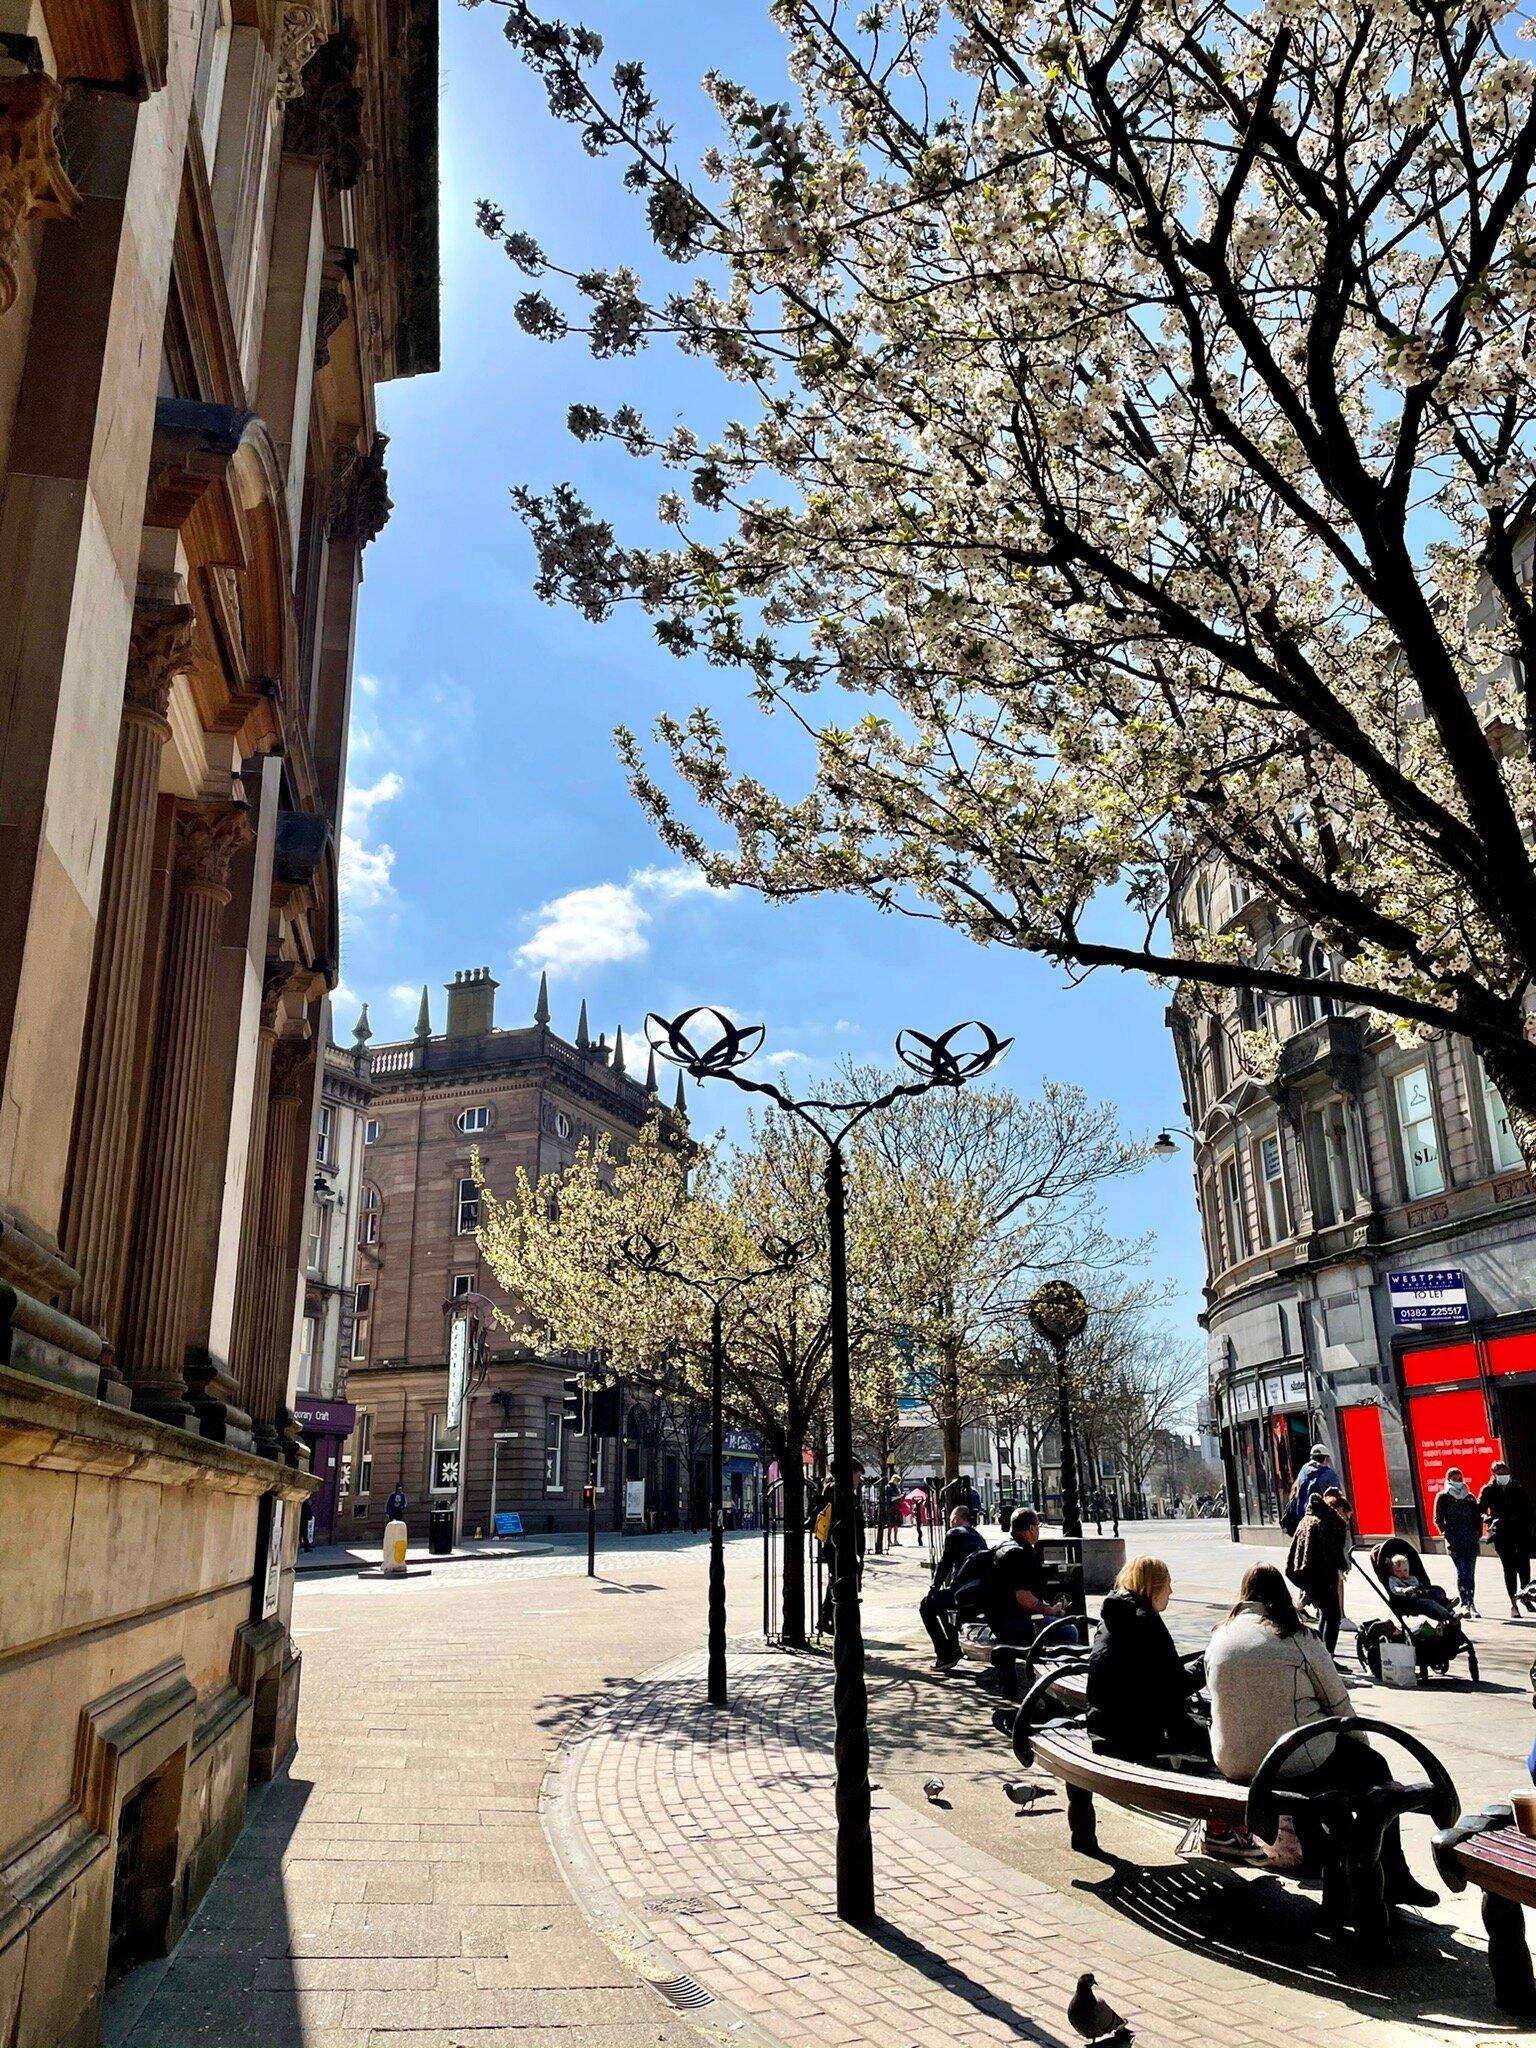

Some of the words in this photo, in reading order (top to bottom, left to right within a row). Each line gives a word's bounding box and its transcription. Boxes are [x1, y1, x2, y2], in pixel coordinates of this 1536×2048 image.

[1414, 1290, 1427, 1299] TO
[1429, 1290, 1443, 1299] LET
[1430, 1306, 1462, 1316] 225517
[316, 1411, 329, 1421] Craft
